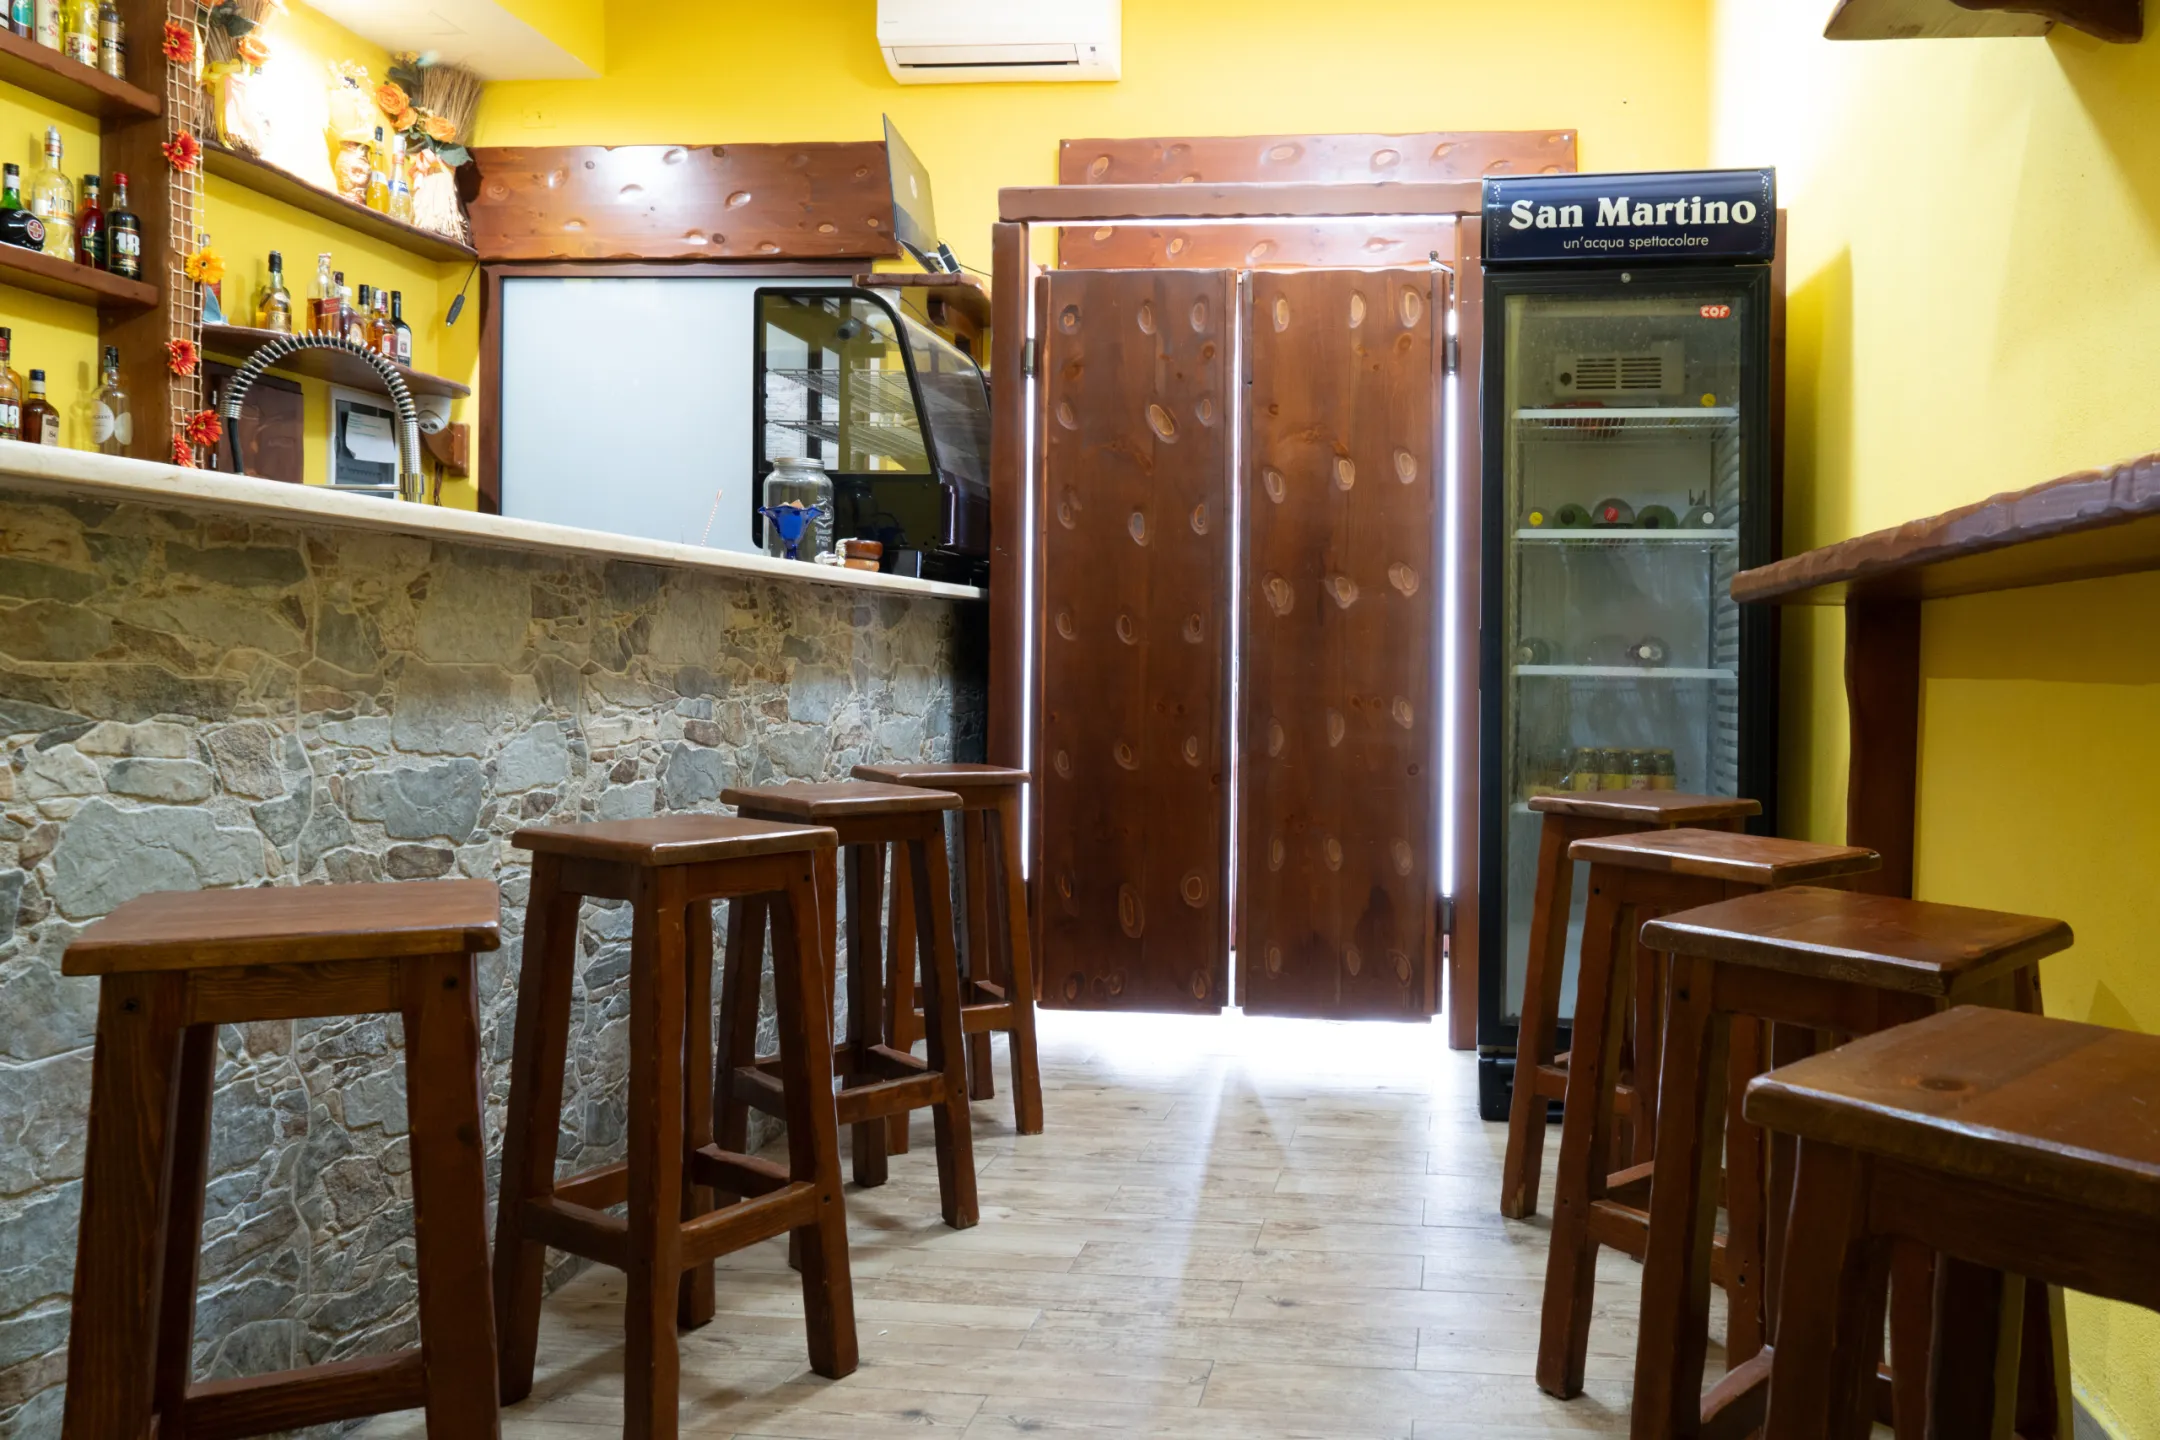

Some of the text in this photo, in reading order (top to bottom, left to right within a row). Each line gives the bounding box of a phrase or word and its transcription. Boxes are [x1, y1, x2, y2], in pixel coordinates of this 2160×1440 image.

[1508, 195, 1757, 230] San Martino
[115, 231, 140, 256] 18
[1563, 232, 1709, 251] un'acqua spettacolare
